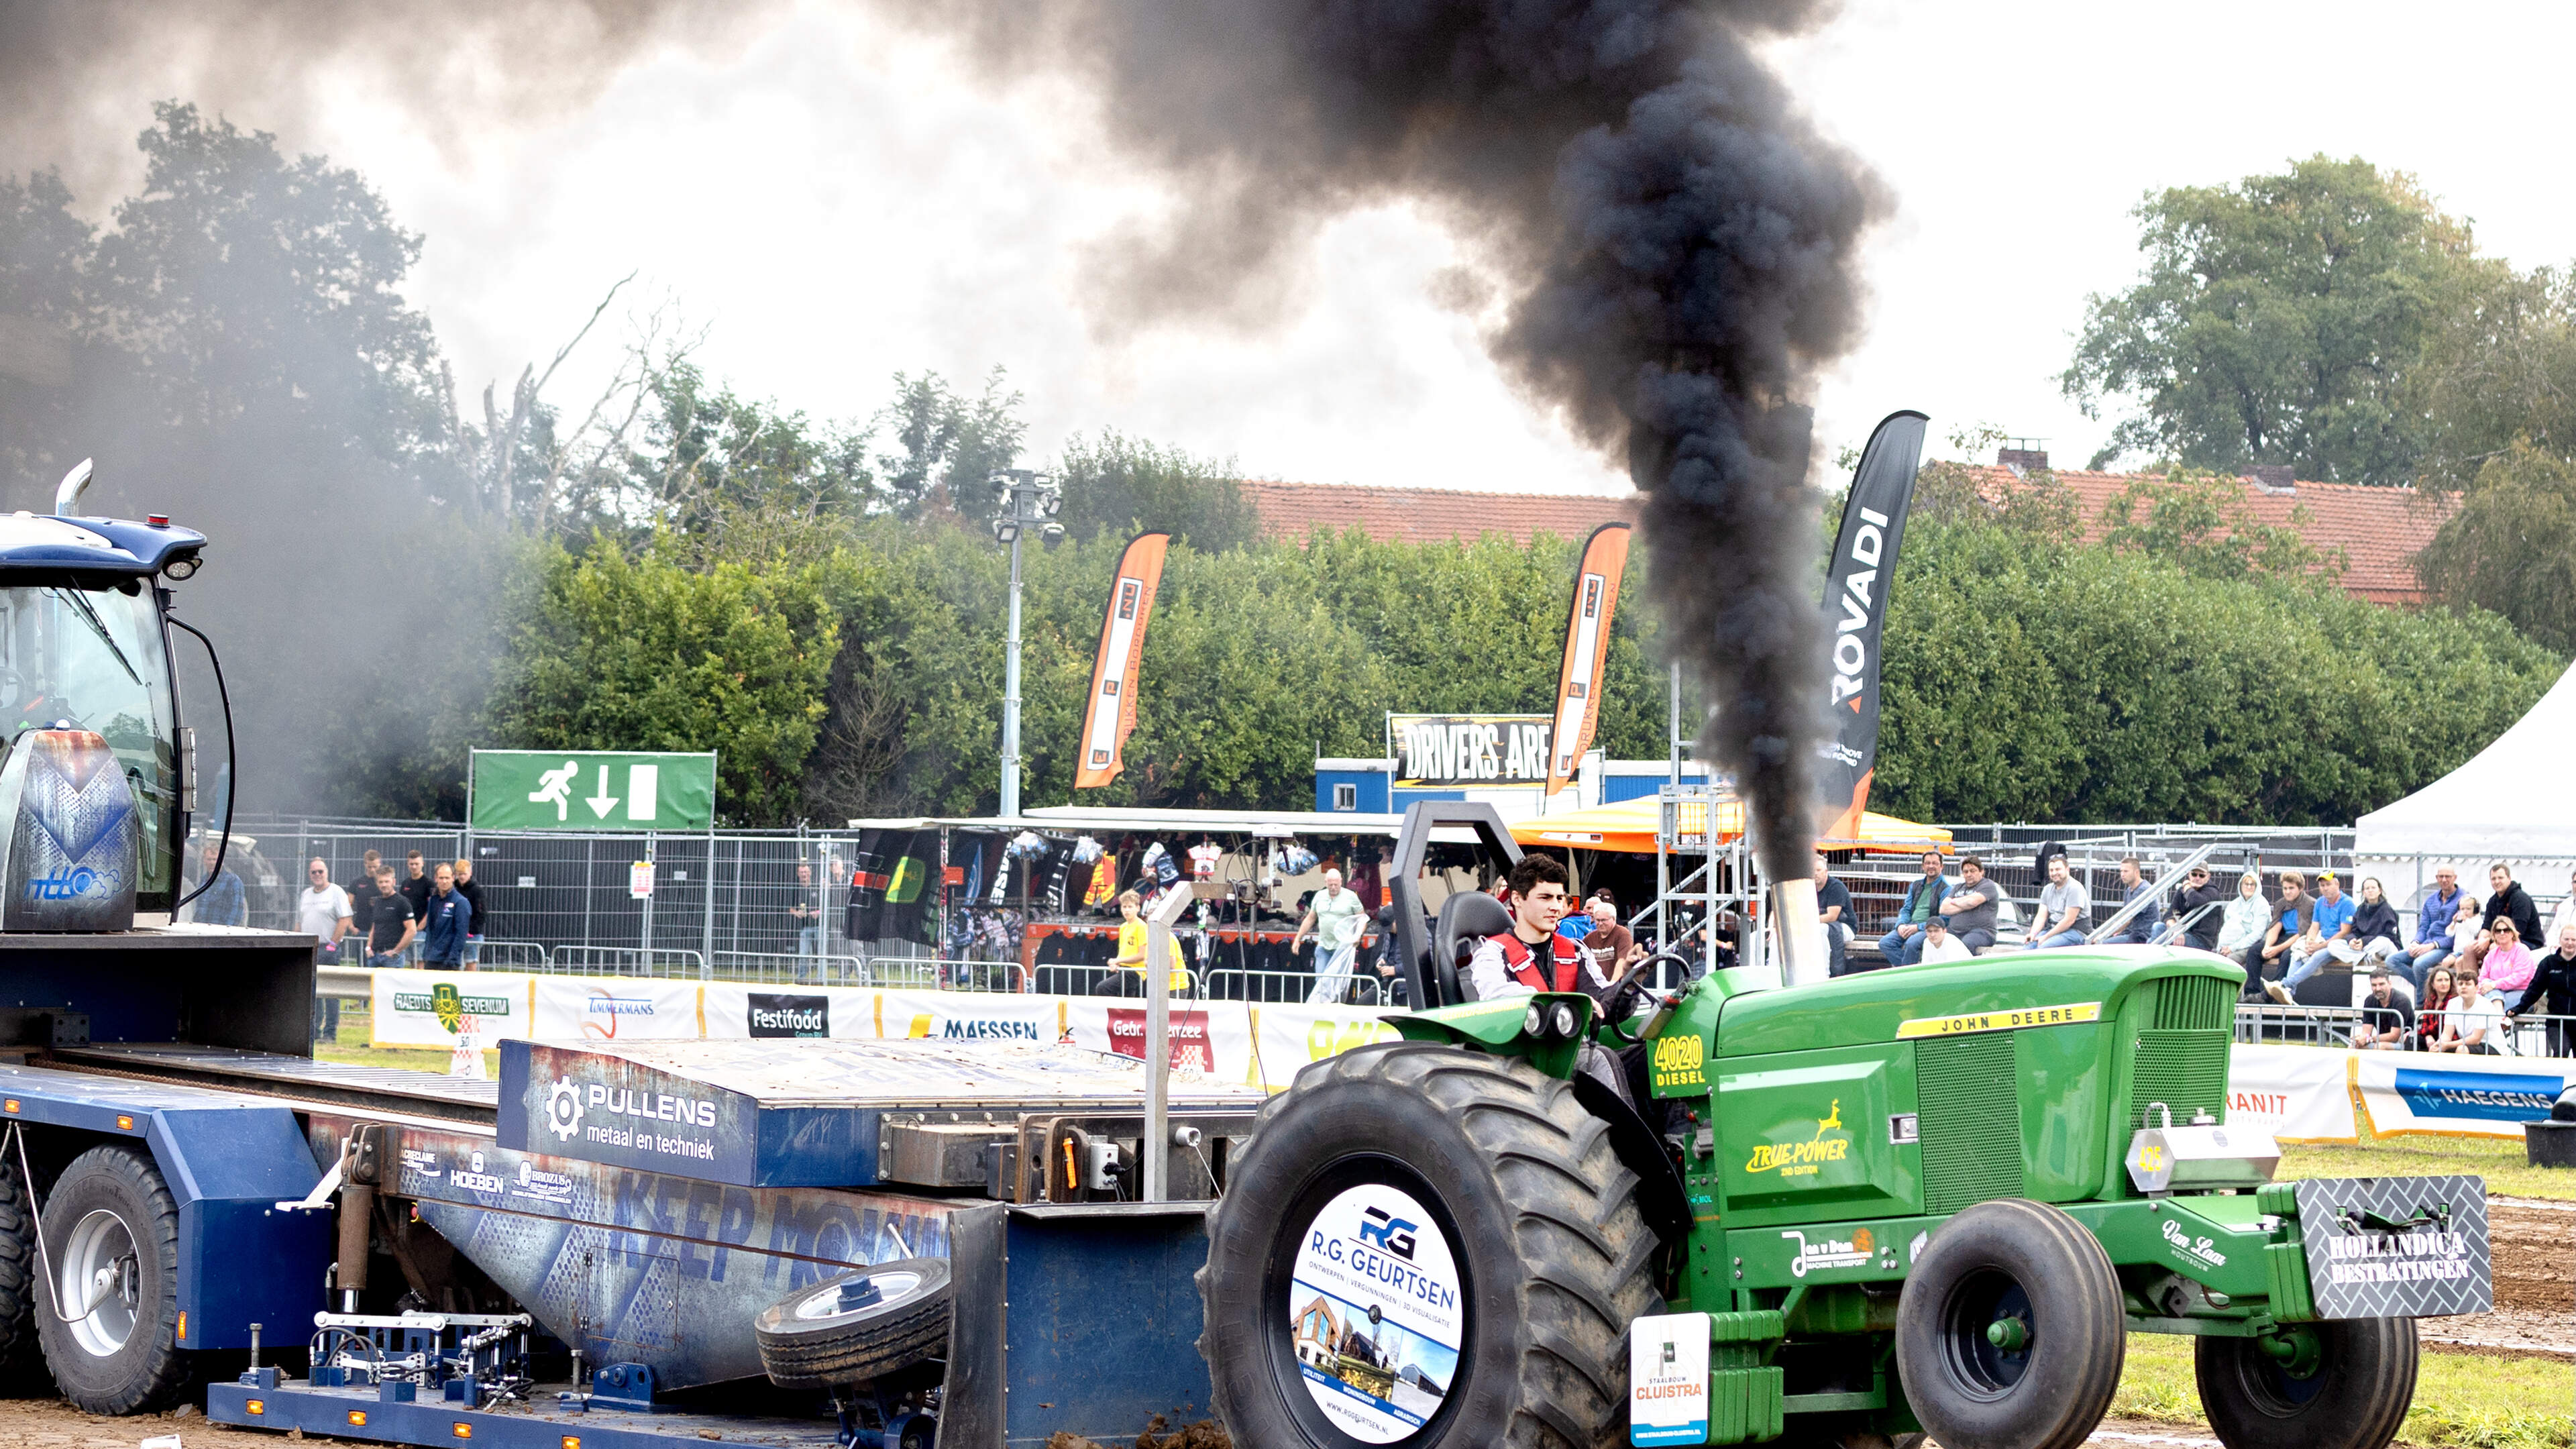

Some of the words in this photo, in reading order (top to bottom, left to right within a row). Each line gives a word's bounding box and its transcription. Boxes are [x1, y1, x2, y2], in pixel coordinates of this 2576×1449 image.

[1831, 507, 1888, 705] ROVADI
[1404, 724, 1499, 780] DRIVERS
[1505, 723, 1550, 780] ARE
[396, 995, 431, 1010] RAEDTS
[462, 998, 507, 1014] SEVENUM
[753, 1008, 822, 1030] Festifood
[945, 1019, 1038, 1040] MAESSEN
[1114, 1020, 1143, 1036] Gebr.
[1941, 1016, 1990, 1032] JOHN
[2012, 1008, 2073, 1026] DEERE
[1655, 1034, 1703, 1073] 4020
[1656, 1072, 1705, 1087] DIESEL
[588, 1083, 716, 1128] PULLENS
[2440, 1087, 2554, 1110] HAEGENS
[587, 1124, 633, 1148] metaal
[636, 1135, 653, 1151] en
[657, 1132, 714, 1161] techniek
[1753, 1142, 1792, 1167] TRUE
[1793, 1138, 1848, 1163] POWER
[1794, 1165, 1819, 1176] EDITION
[2138, 1146, 2162, 1172] 425
[450, 1169, 504, 1194] HOEBEN
[532, 1170, 566, 1185] BROZUS
[610, 1171, 755, 1283] KEEP
[1359, 1205, 1419, 1261] RG
[2162, 1220, 2190, 1248] Van
[2190, 1236, 2226, 1267] Laar
[2328, 1232, 2467, 1260] HOLLANDICA
[1311, 1230, 1345, 1265] R.G.
[1351, 1248, 1455, 1311] GEURTSEN
[1833, 1258, 1867, 1268] TRANSPORT
[2170, 1248, 2209, 1272] HOUTBOUW
[2332, 1257, 2469, 1284] BESTRATINGEN
[1309, 1260, 1345, 1282] ONTWERPEN
[1350, 1277, 1397, 1305] VERGUNNINGEN
[1412, 1305, 1450, 1329] VISUALISATIE
[1636, 1383, 1702, 1400] CLUISTRA
[1650, 1376, 1687, 1385] STAALBOUW
